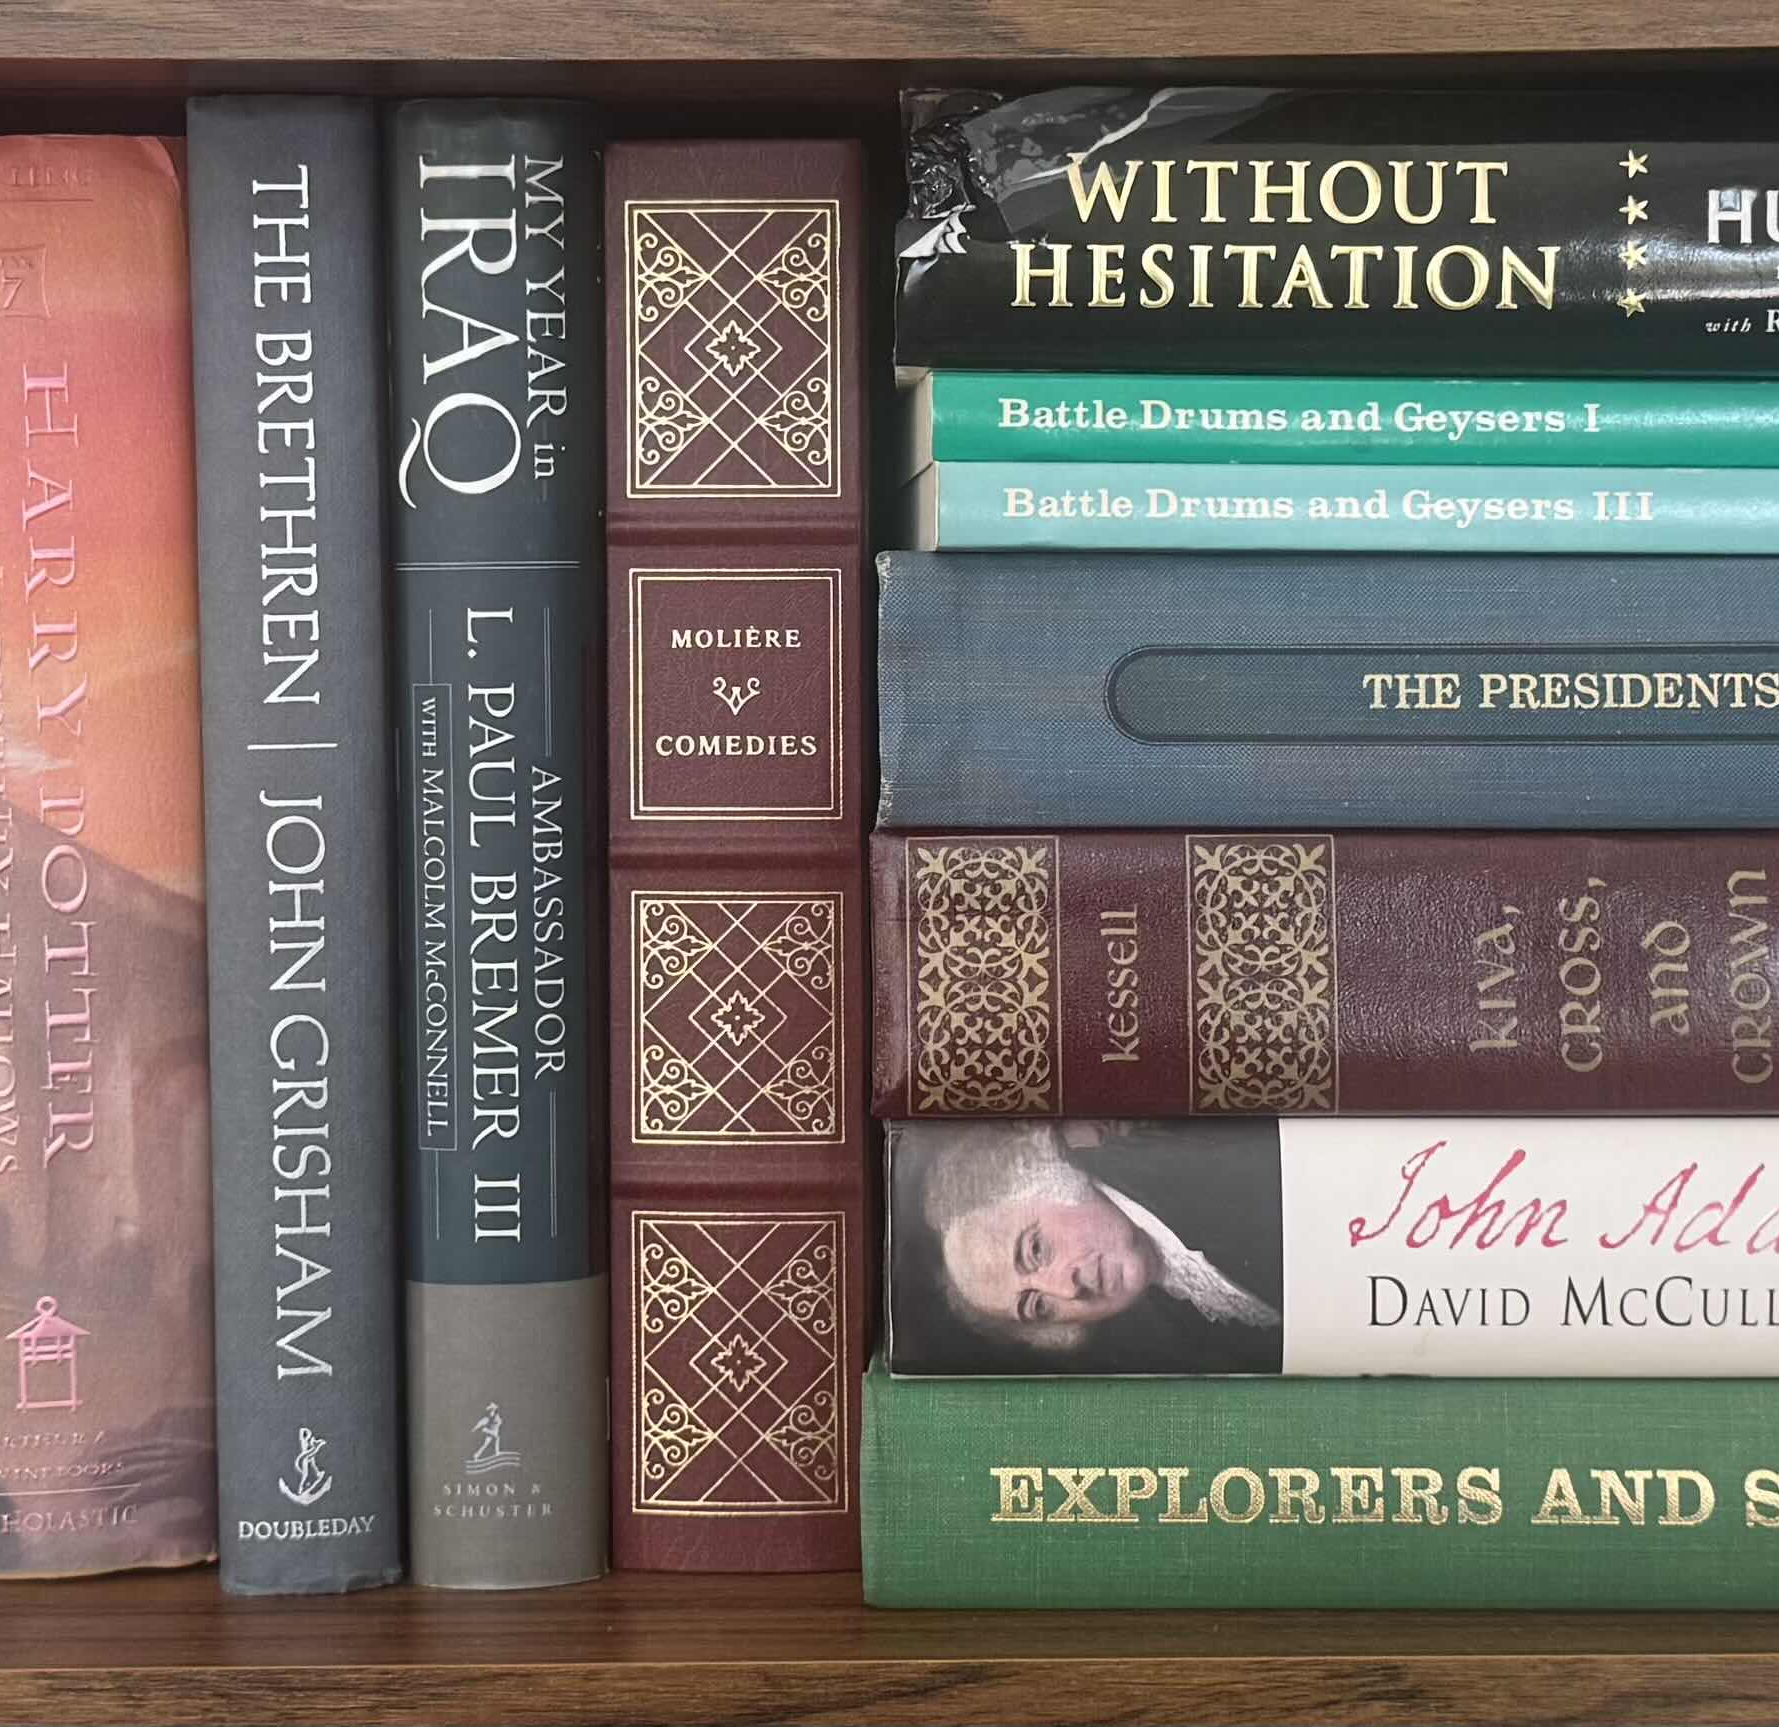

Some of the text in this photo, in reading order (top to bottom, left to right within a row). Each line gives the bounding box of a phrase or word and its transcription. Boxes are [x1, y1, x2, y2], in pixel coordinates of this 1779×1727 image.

[1066, 152, 1510, 226] WITHOUT
[1009, 243, 1561, 313] HESITATION
[396, 154, 522, 510] IRAQ
[524, 153, 569, 480] MY YEAR in
[1705, 316, 1754, 336] with
[997, 398, 1601, 442] Battle Drums and Geysers I
[1002, 487, 1654, 530] Battle Drums and Geysers III
[671, 625, 801, 649] MOLIÈRE
[1362, 673, 1462, 711] THE
[22, 363, 98, 1170] HARRY POTTER
[251, 163, 333, 1381] THE BRETHREN JOHN GRISHAM
[655, 735, 818, 756] COMEDIES
[421, 698, 451, 1138] WITH MALCOLM McCONNELL
[466, 607, 521, 1244] L. PAUL BREMER III
[530, 765, 567, 1081] AMBASSADOR
[1559, 876, 1608, 1074] CROSS,
[1350, 1140, 1569, 1250] John
[1368, 1275, 1531, 1328] DAVID
[238, 1513, 376, 1541] DOUBLEDAY
[989, 1465, 1503, 1526] EXPLORERS
[1530, 1467, 1715, 1527] AND
